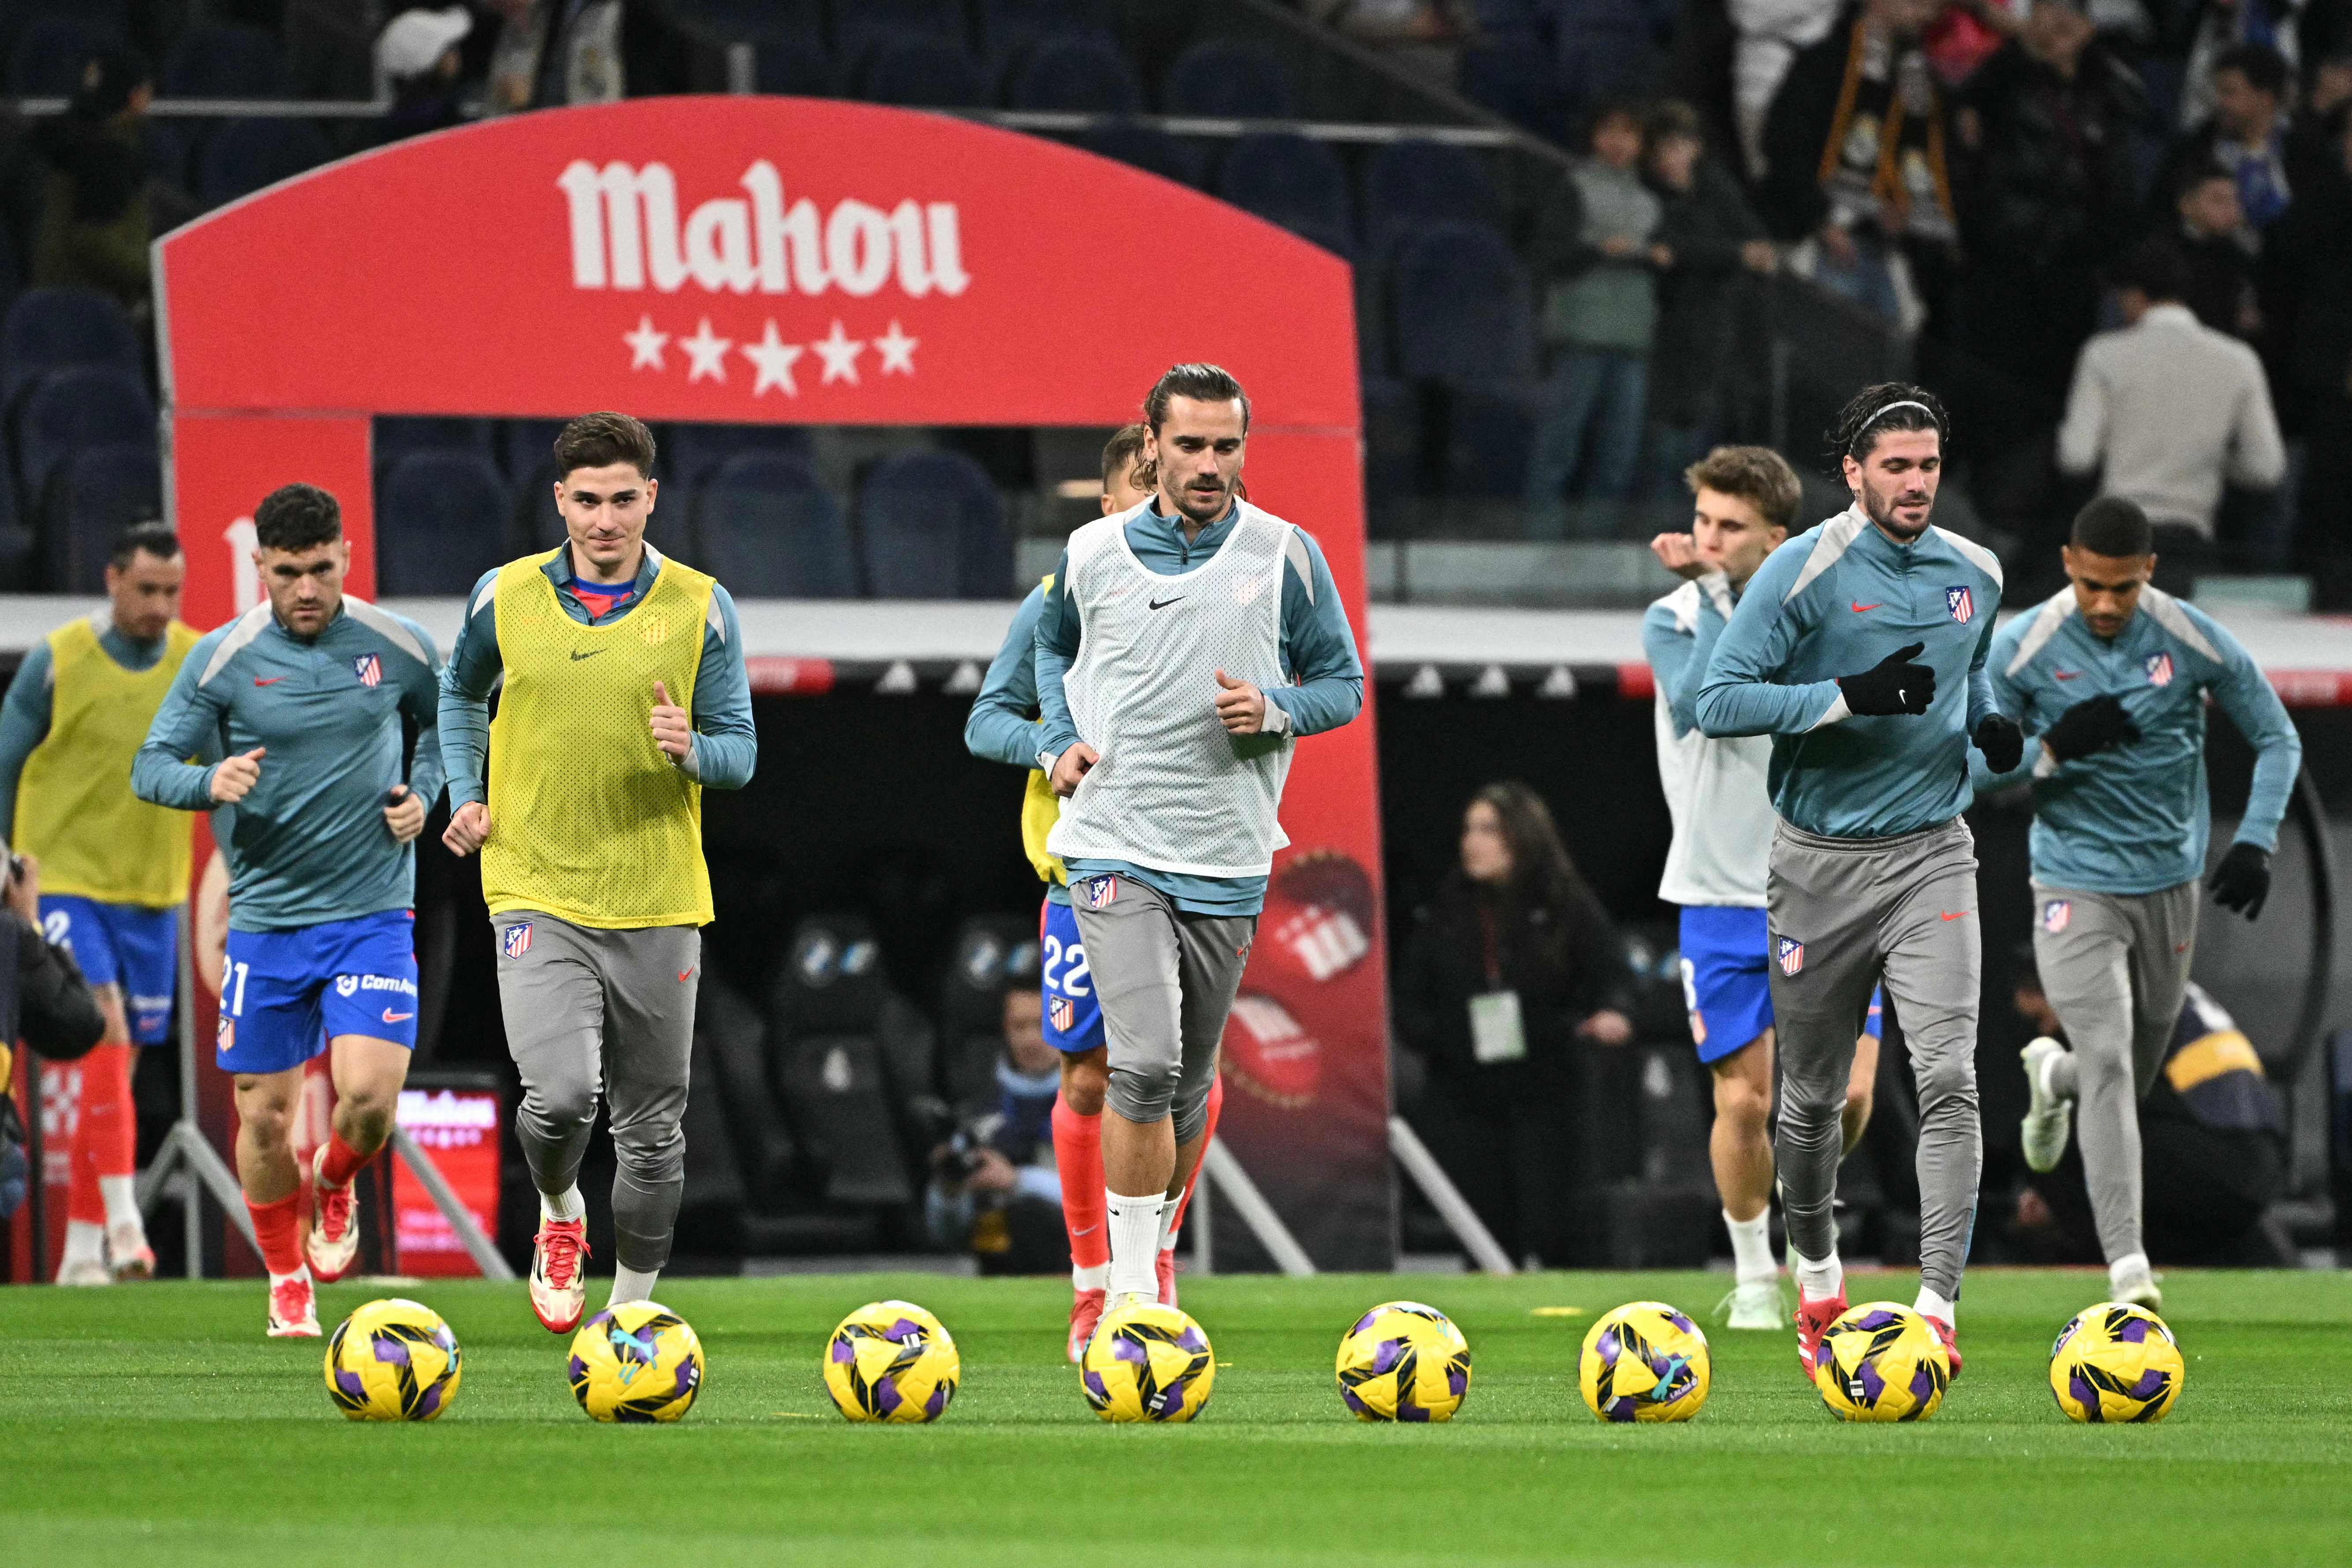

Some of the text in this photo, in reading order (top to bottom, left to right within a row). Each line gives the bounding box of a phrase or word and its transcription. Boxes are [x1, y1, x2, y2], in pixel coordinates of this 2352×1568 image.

[557, 159, 971, 298] Mahou
[1044, 935, 1090, 997] 22
[1669, 1382, 1693, 1400] LALIGA
